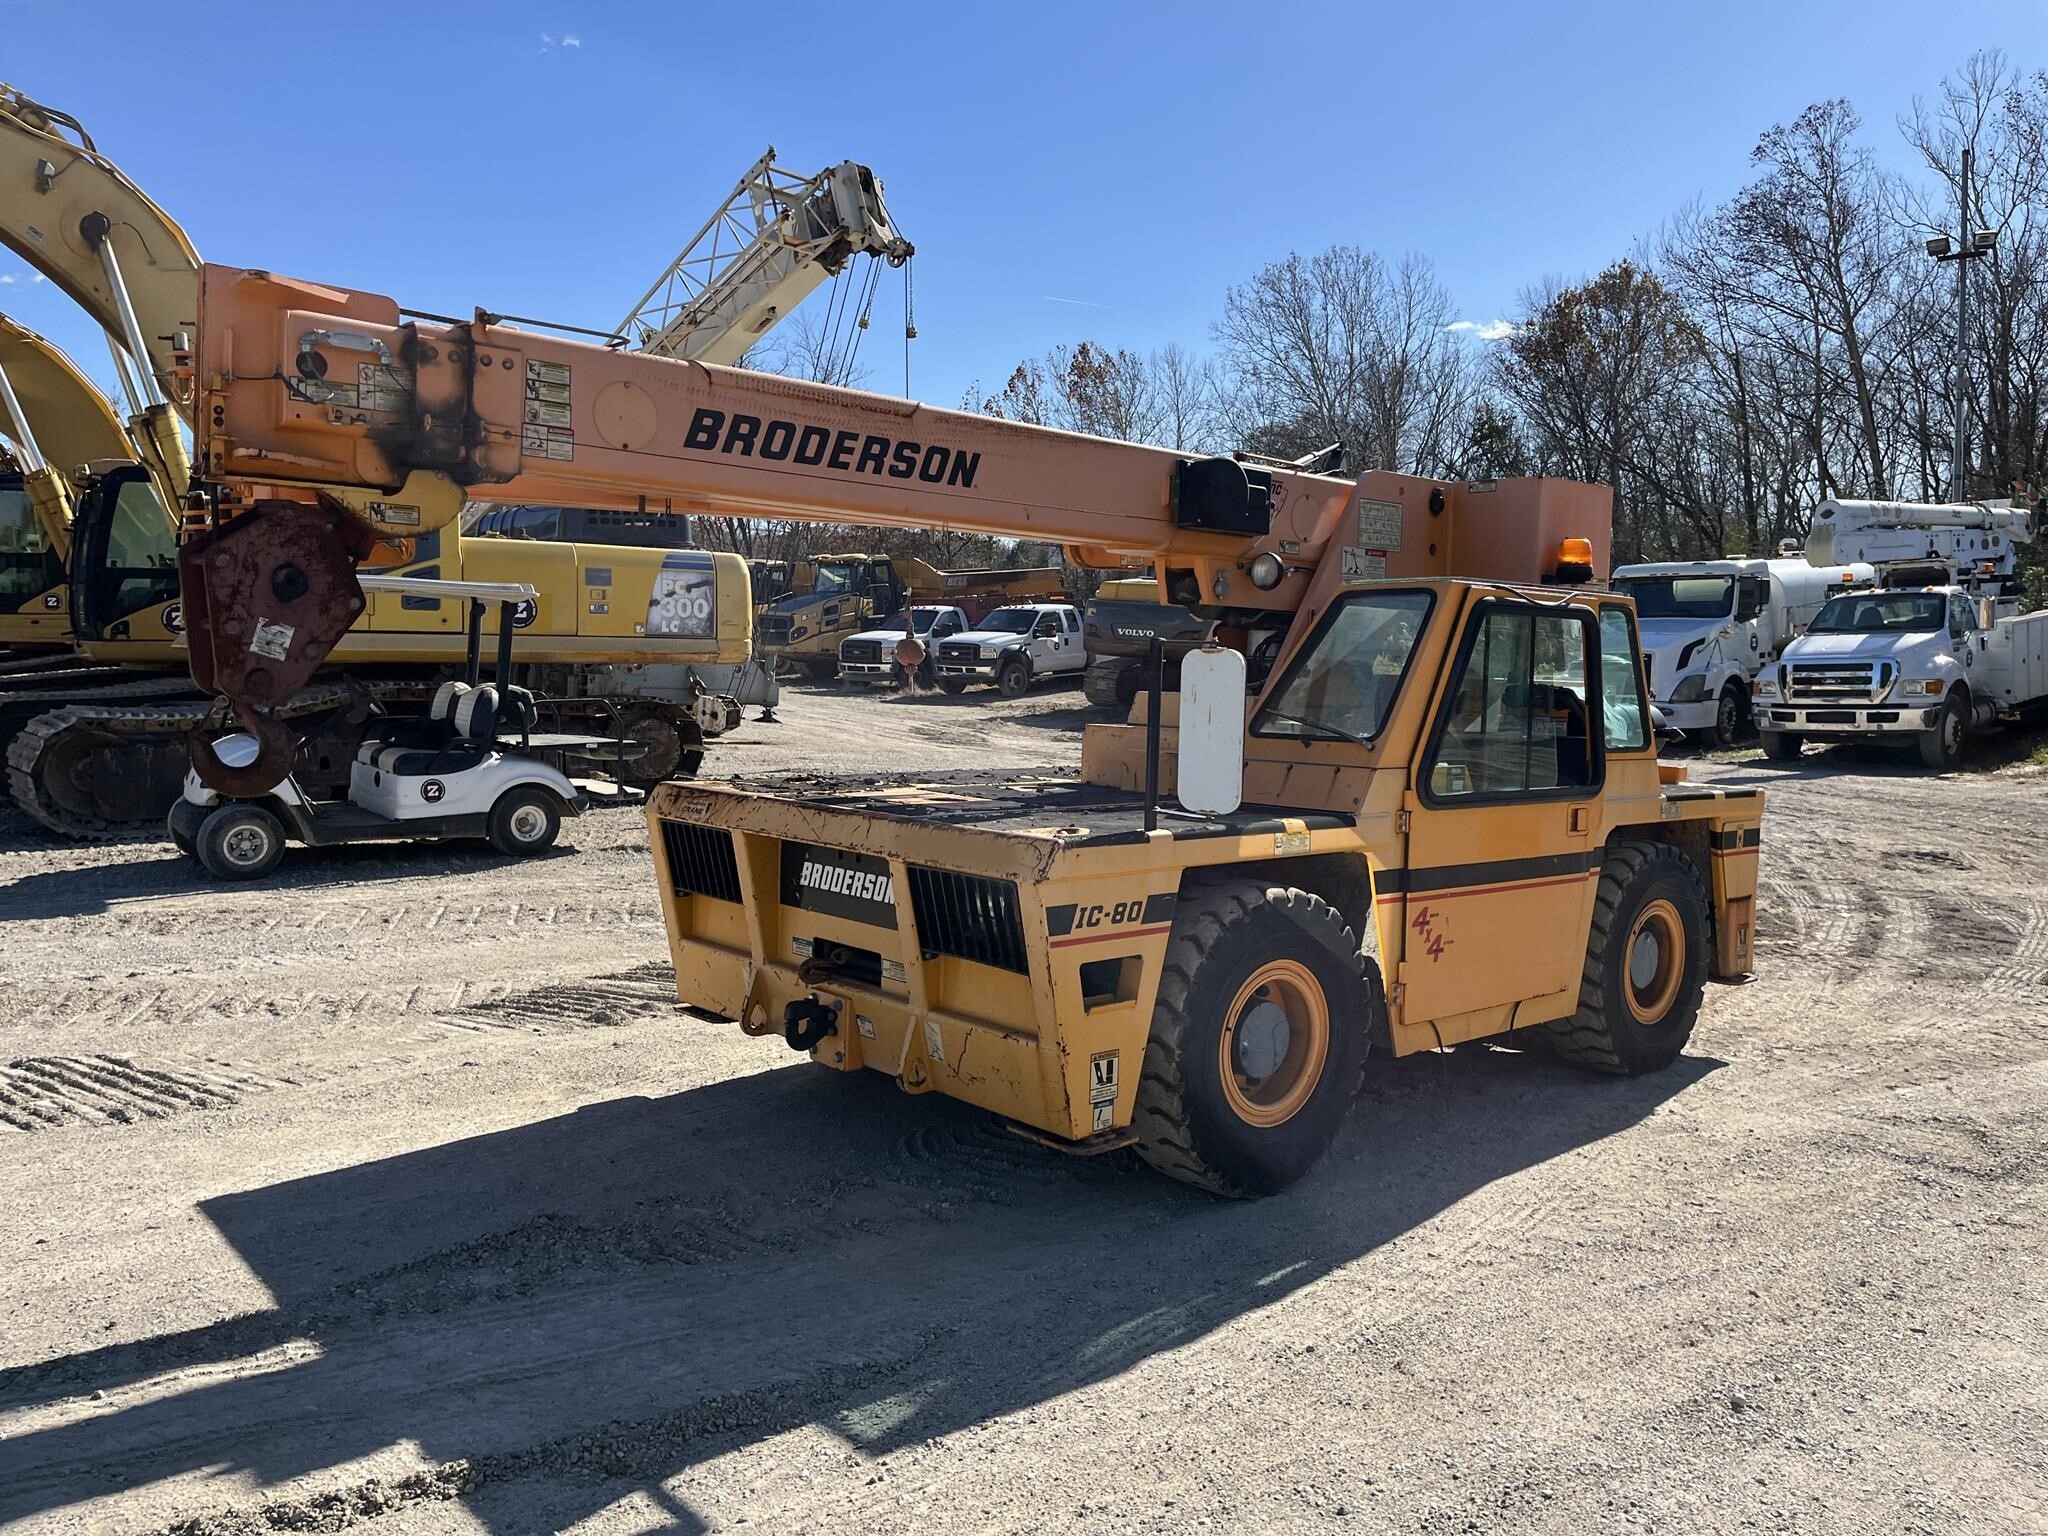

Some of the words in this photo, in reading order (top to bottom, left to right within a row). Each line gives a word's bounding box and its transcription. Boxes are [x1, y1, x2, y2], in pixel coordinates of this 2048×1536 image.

[683, 408, 981, 488] BRODERSON
[47, 597, 57, 606] Z
[660, 597, 709, 618] 300
[661, 620, 679, 632] LC
[1117, 628, 1154, 637] VOLVO
[427, 785, 439, 797] Z
[1075, 900, 1143, 929] IC-80
